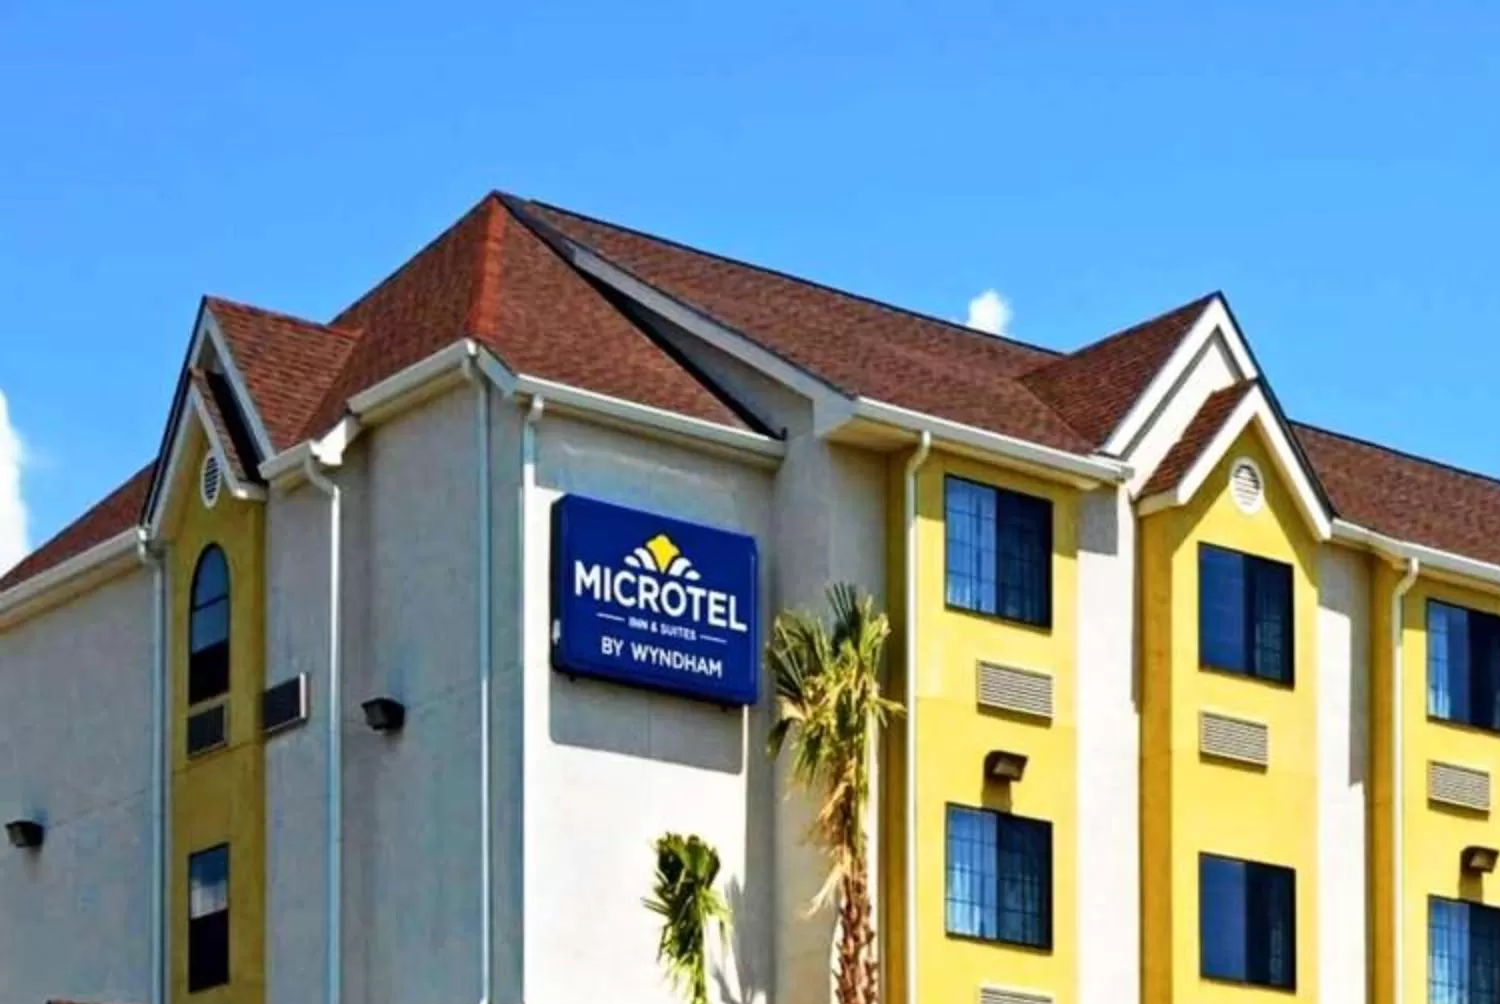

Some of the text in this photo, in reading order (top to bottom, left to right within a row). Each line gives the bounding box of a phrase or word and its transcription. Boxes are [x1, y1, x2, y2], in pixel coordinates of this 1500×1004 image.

[574, 560, 748, 632] MICROTEL
[601, 636, 723, 679] BY WYNDHAM
